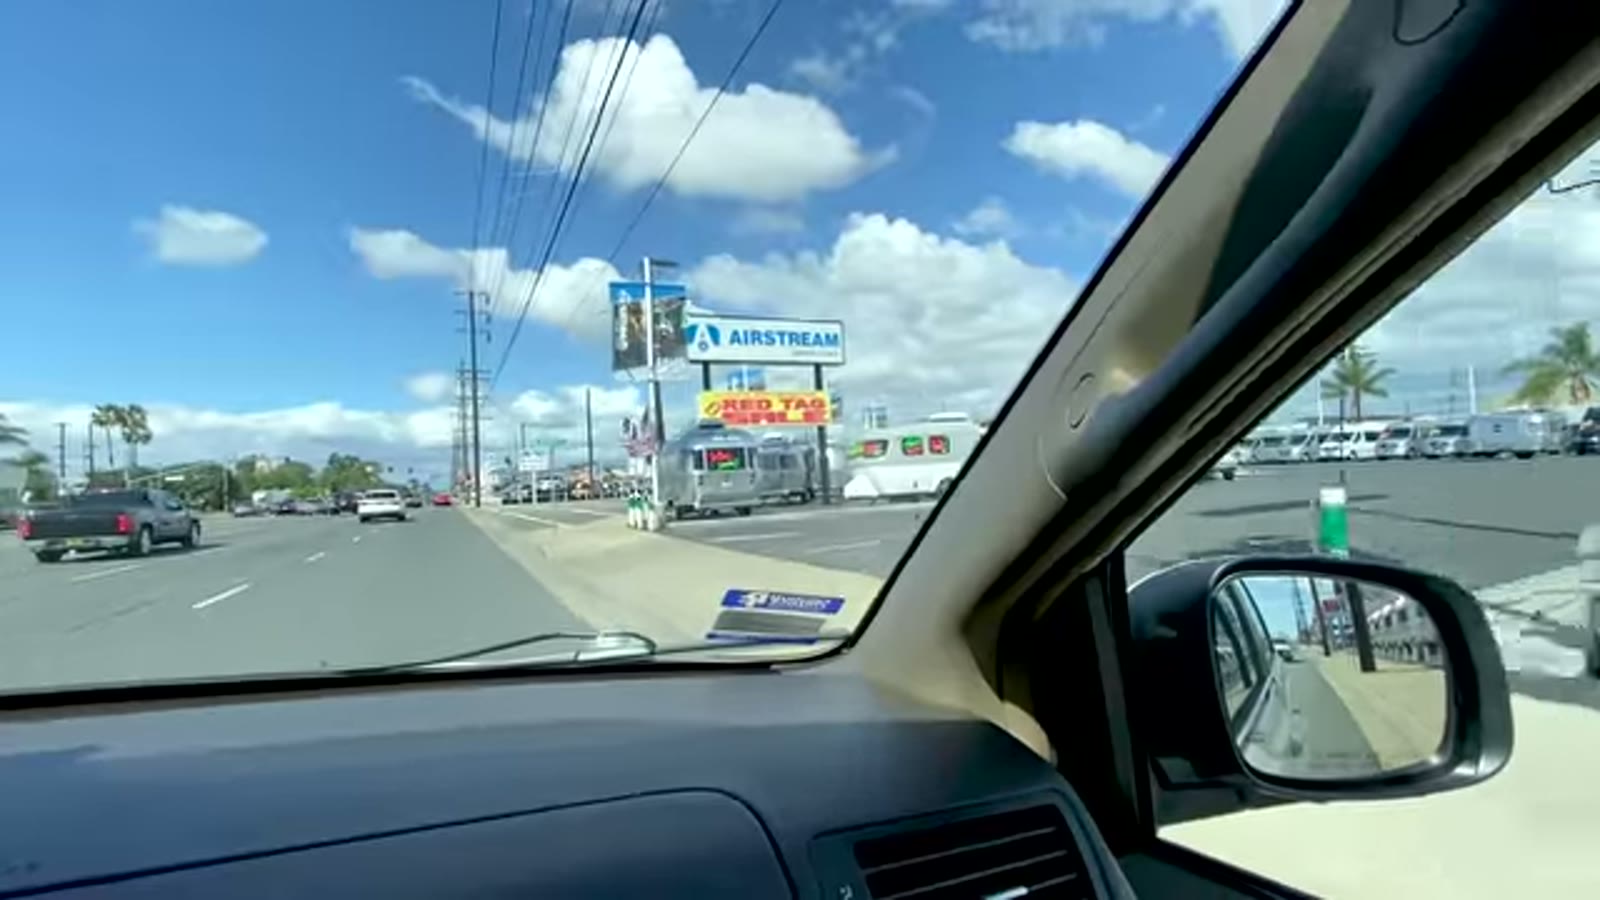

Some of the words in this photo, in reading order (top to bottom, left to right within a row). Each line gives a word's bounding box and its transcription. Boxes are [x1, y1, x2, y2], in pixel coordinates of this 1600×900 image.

[729, 329, 839, 347] AIRSTREAM
[721, 398, 773, 411] RED
[780, 397, 827, 411] TAG
